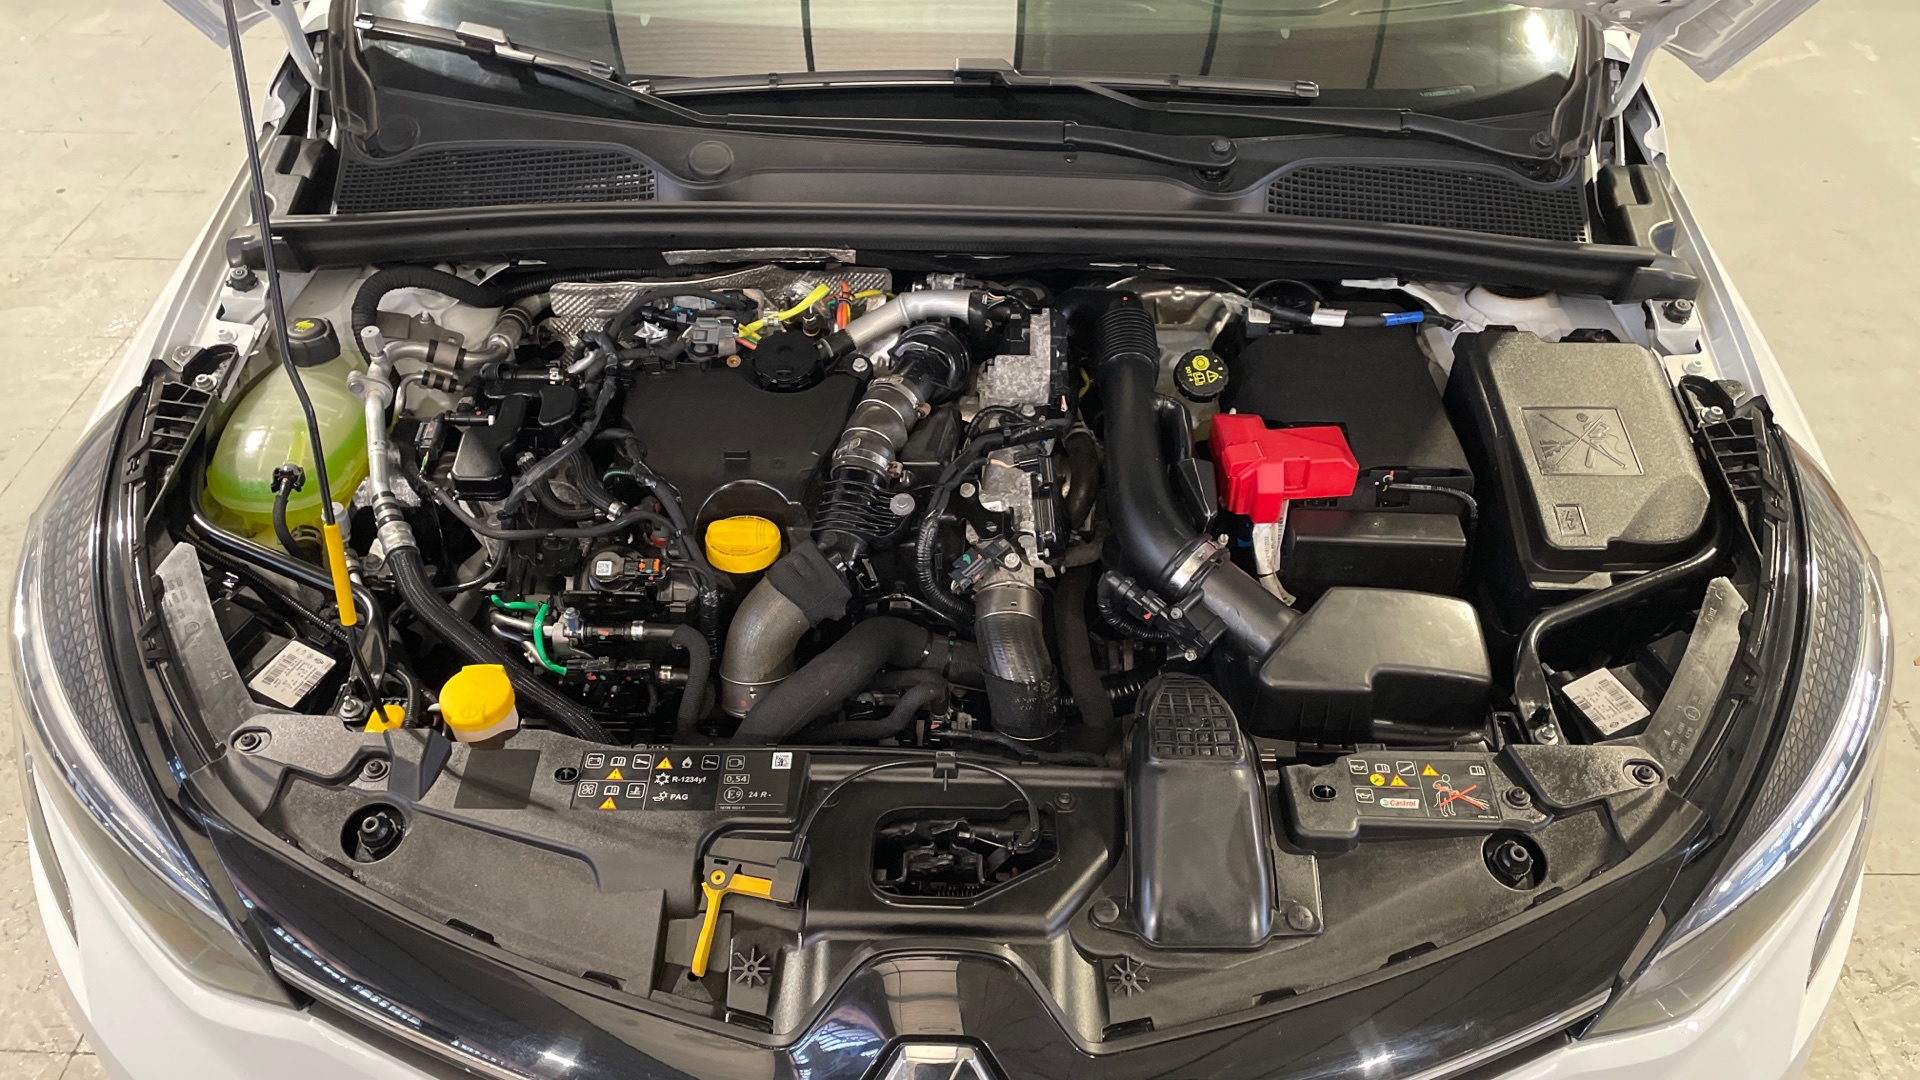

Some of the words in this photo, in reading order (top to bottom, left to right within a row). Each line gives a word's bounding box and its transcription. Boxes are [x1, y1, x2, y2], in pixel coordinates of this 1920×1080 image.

[671, 776, 706, 784] R-1234yf
[726, 775, 747, 784] 0,54
[669, 793, 689, 801] PAG
[727, 790, 741, 799] E9
[1389, 799, 1417, 808] Castrol
